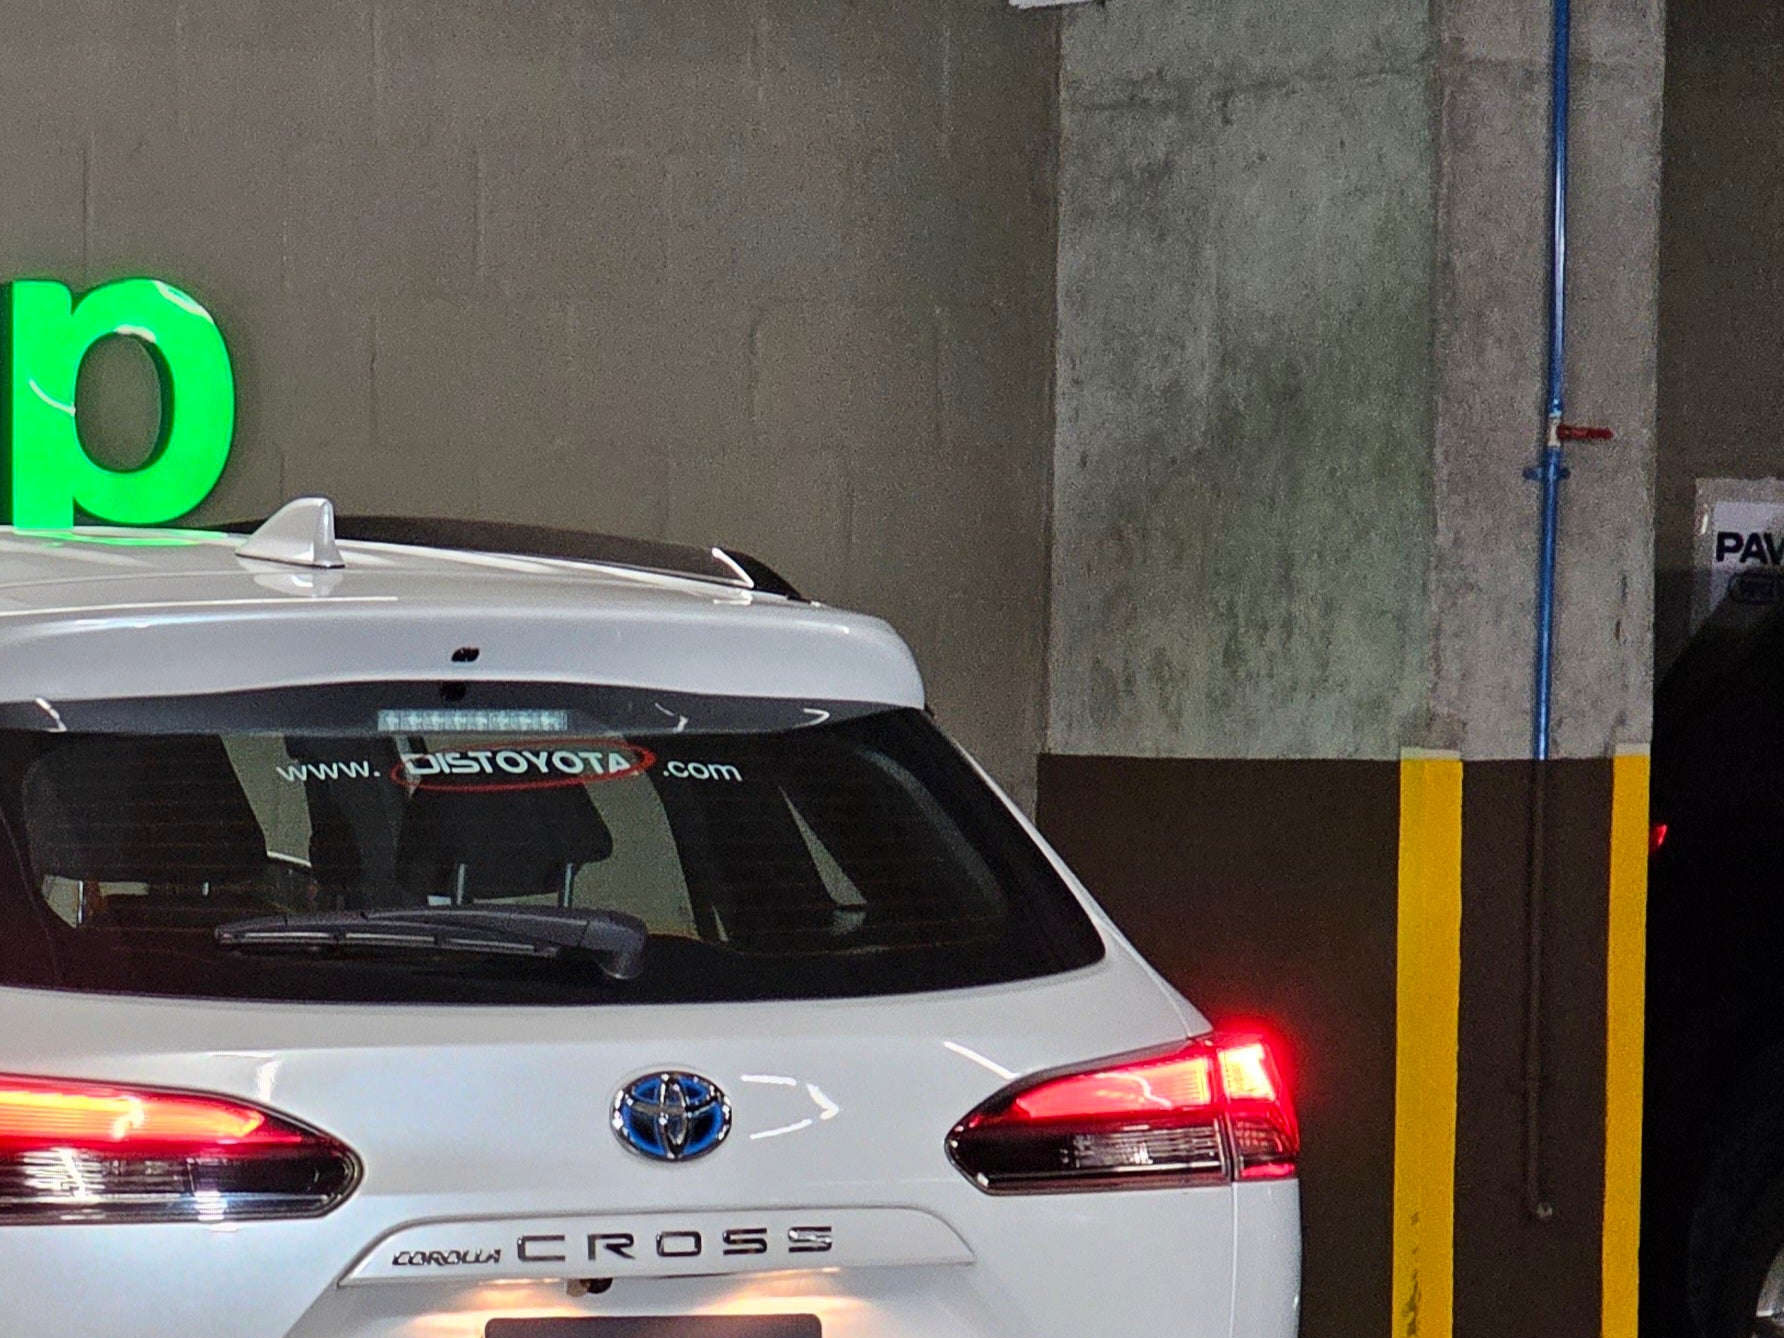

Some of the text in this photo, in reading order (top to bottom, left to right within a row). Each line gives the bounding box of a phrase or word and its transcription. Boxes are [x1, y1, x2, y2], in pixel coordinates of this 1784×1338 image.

[277, 750, 743, 783] www. DISTOYOTA .com
[391, 1226, 833, 1266] COROLLA CROSS
